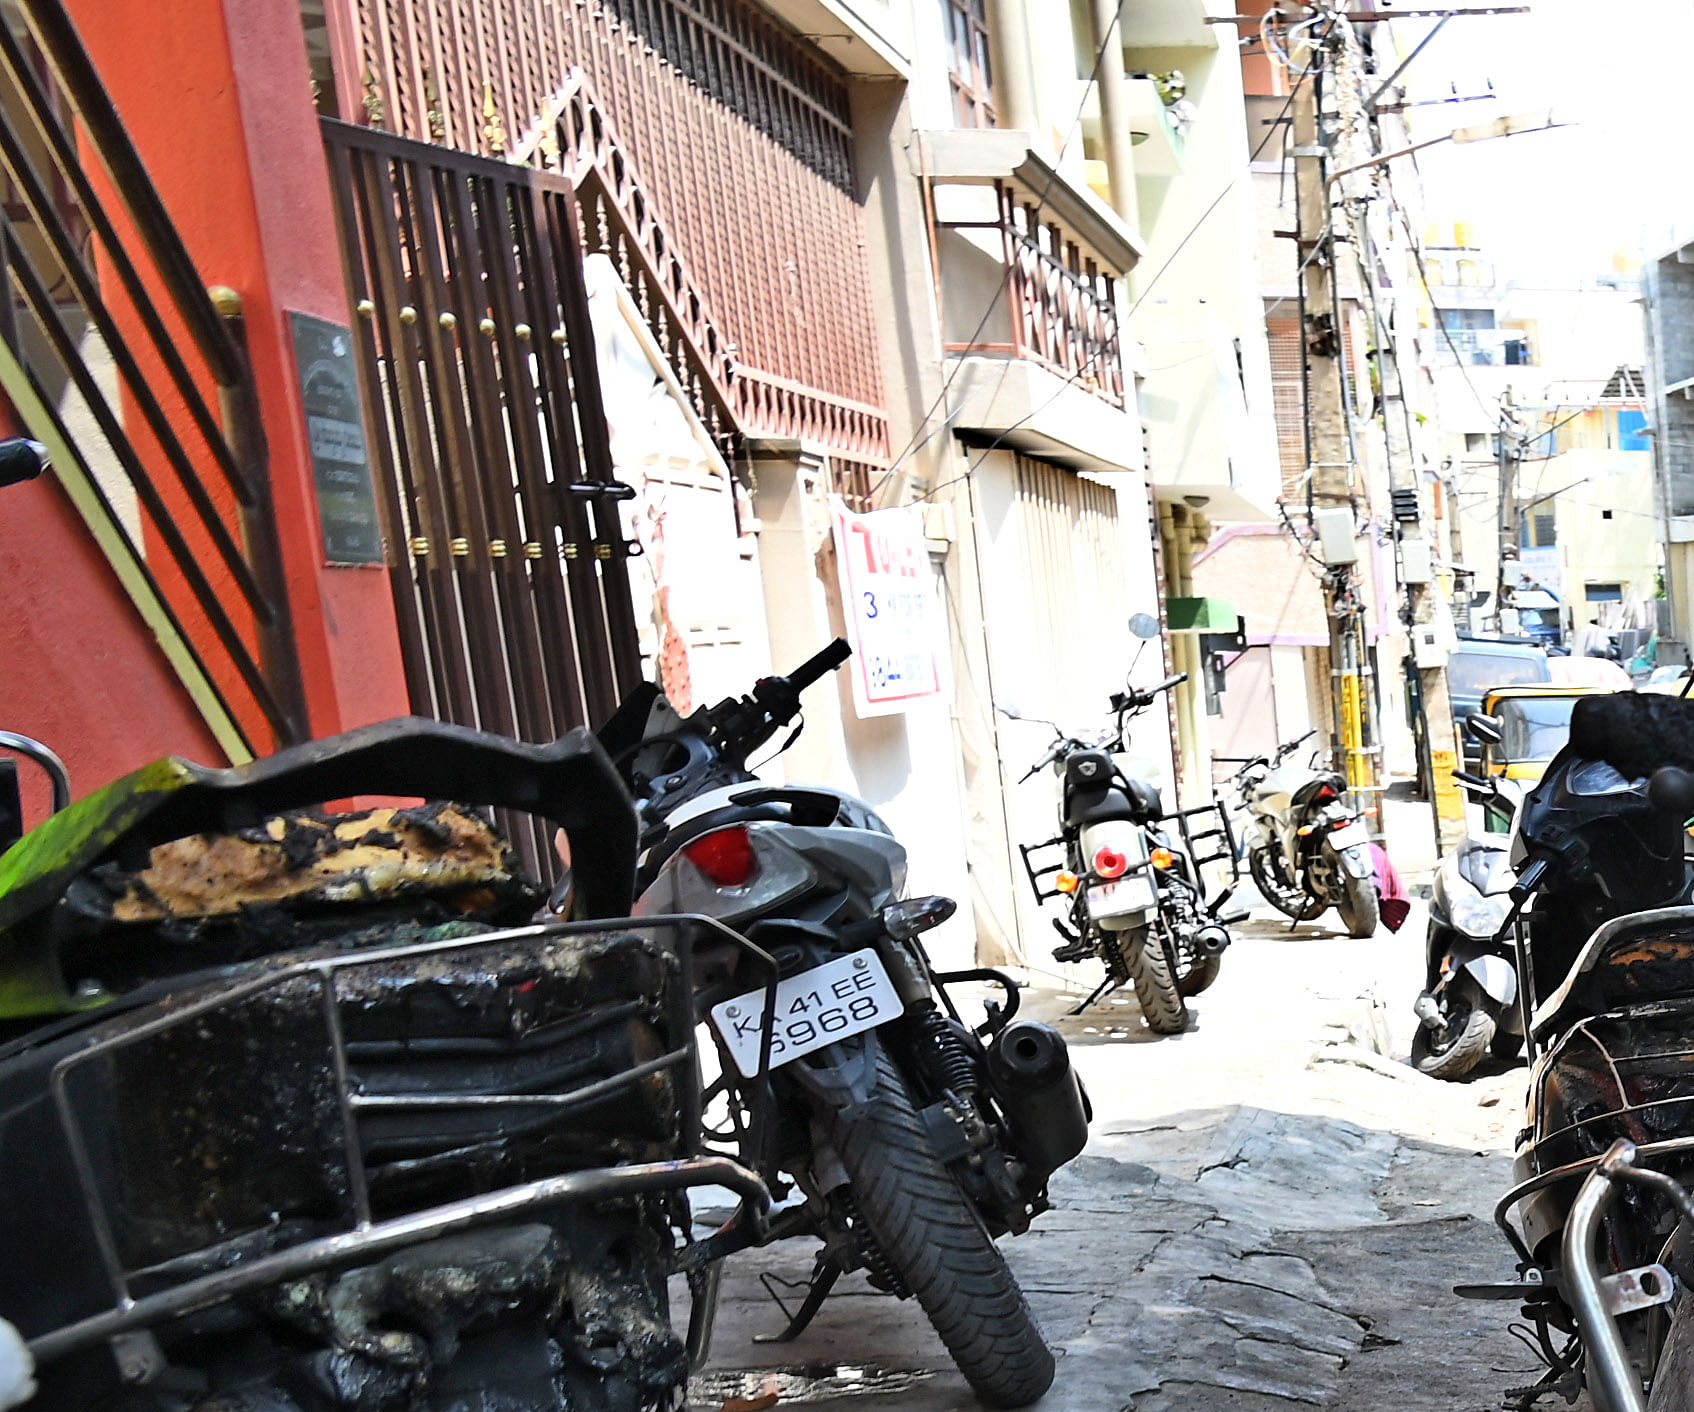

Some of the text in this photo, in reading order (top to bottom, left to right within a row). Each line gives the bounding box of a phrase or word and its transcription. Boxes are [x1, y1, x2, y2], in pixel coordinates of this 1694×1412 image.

[863, 591, 878, 619] 3
[788, 991, 824, 1015] 41
[831, 970, 877, 1000] EE
